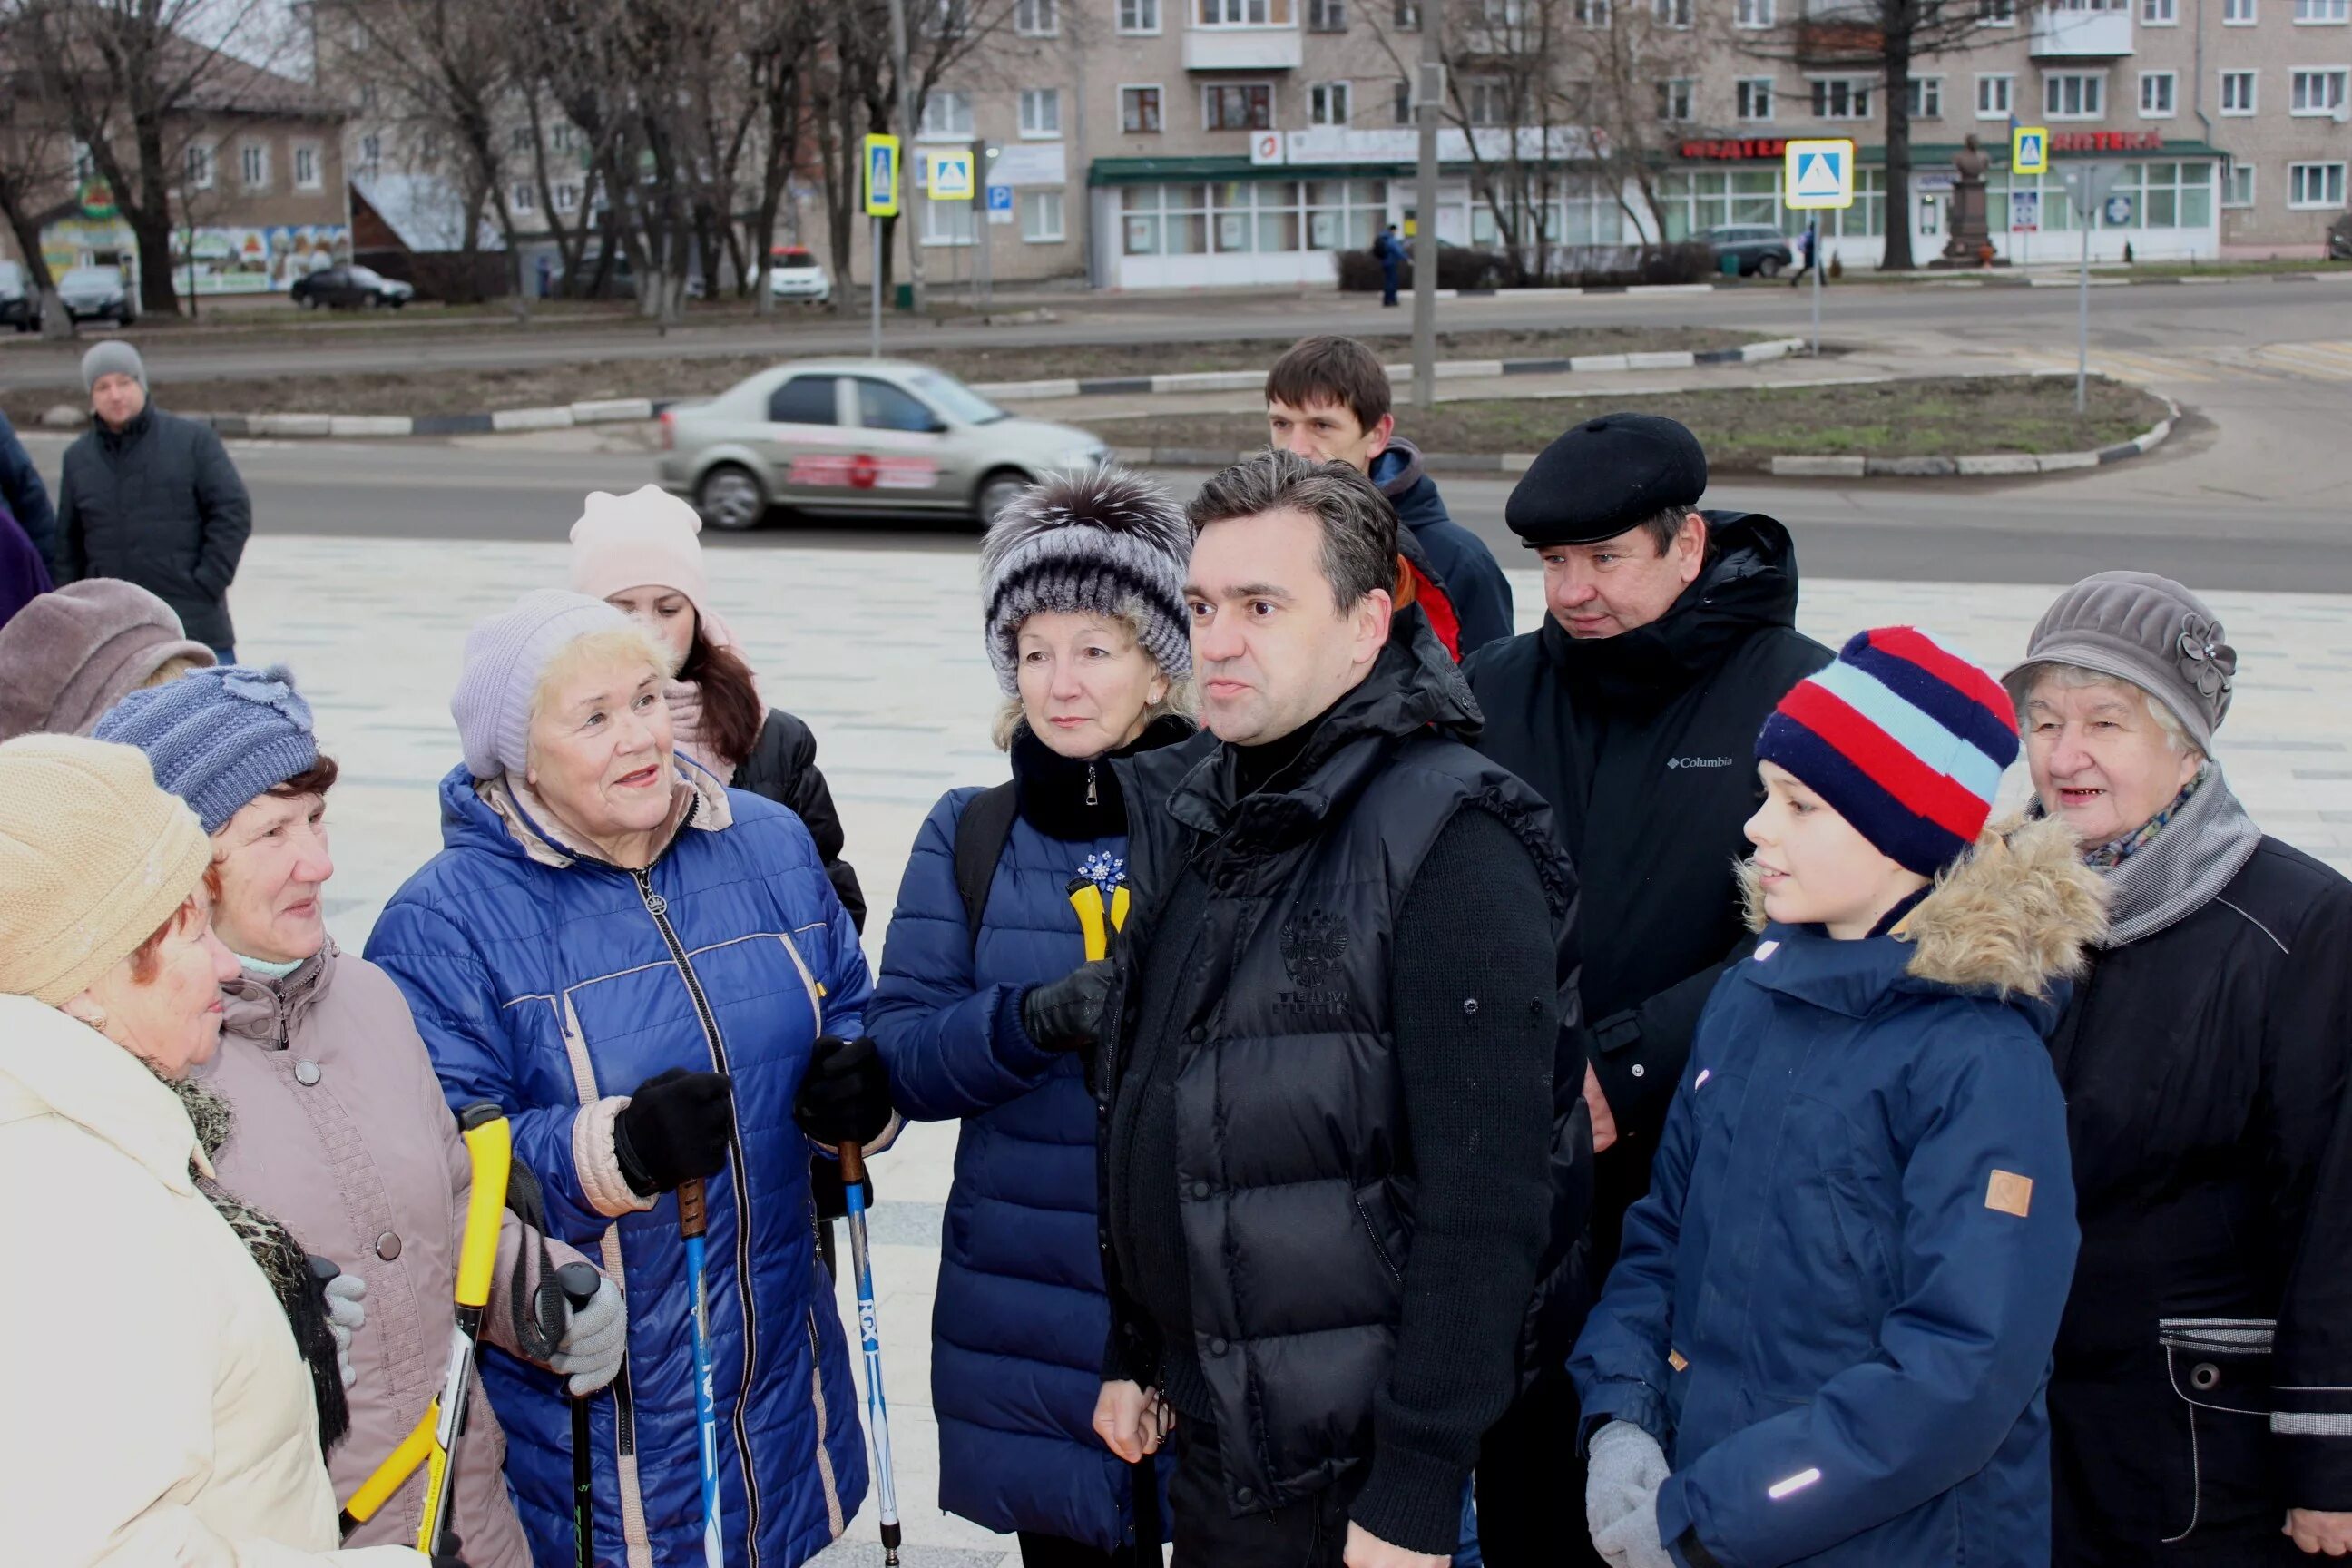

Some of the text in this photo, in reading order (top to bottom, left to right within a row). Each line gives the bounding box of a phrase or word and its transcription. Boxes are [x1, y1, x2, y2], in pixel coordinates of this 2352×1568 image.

[2053, 131, 2164, 152] АПТЕКА
[1680, 756, 1732, 769] Columbia
[1277, 991, 1348, 1003] TEAM
[1272, 1002, 1350, 1014] PUTIN
